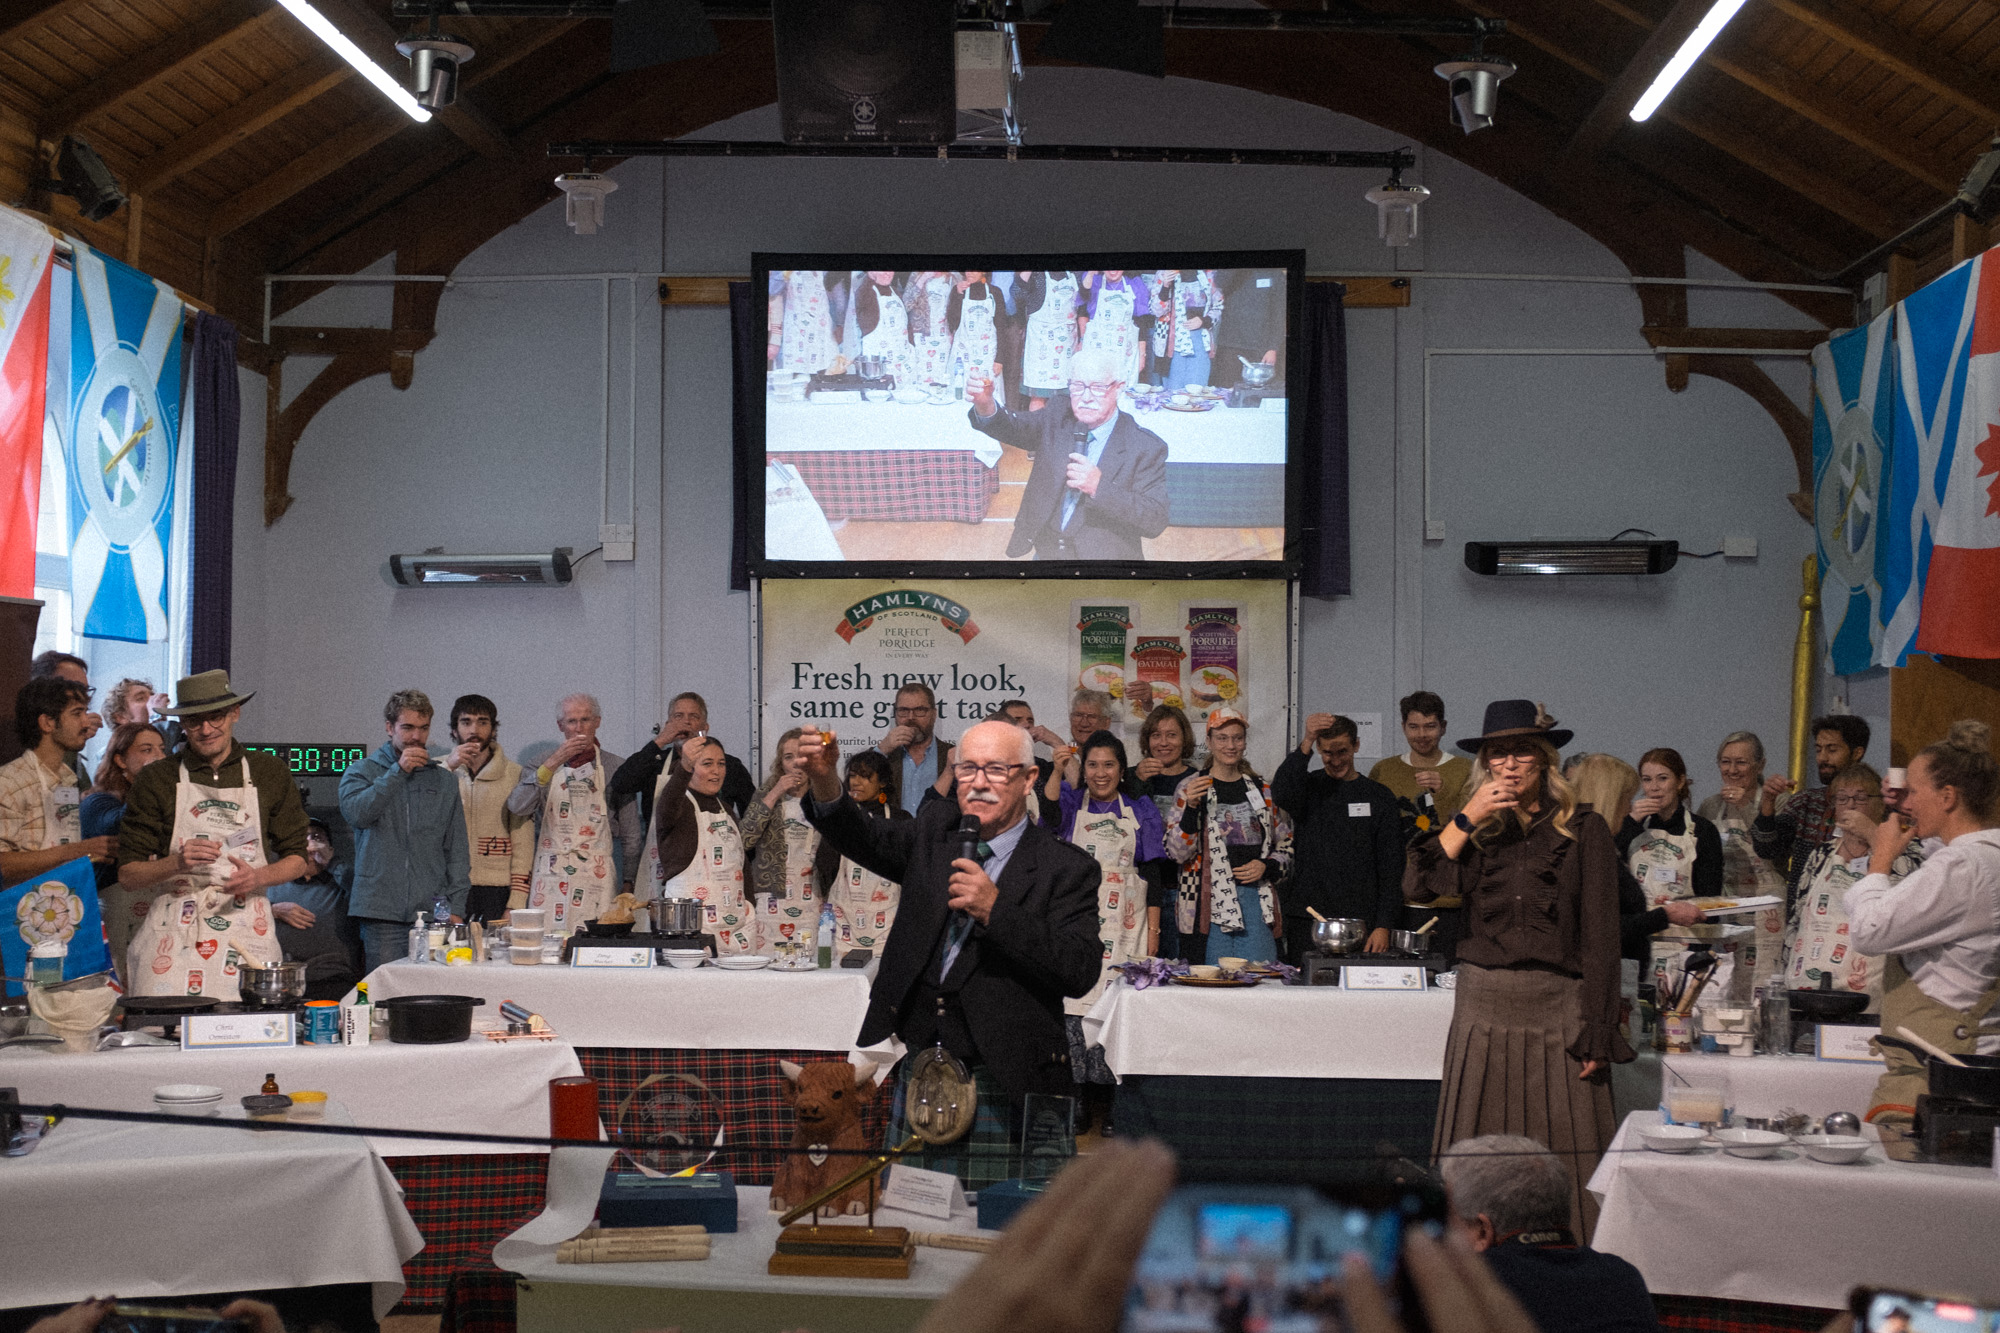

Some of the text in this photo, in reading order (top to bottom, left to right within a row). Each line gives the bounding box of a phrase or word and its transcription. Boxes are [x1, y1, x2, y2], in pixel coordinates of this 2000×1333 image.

[852, 593, 962, 619] HAMLYNS
[892, 611, 938, 621] SCOTLAND
[1082, 611, 1127, 623] HAMLYNS
[1191, 613, 1235, 624] HAMLYNS
[884, 627, 931, 637] PERFECT
[879, 638, 936, 648] PORRIDGE
[1136, 640, 1181, 652] HAMLYNS
[1190, 636, 1237, 646] PORRIDGE
[1137, 660, 1179, 668] OATMEAL
[791, 662, 1026, 697] Fresh new look,
[790, 698, 1006, 728] same grt tas
[1518, 1232, 1561, 1244] Canon
